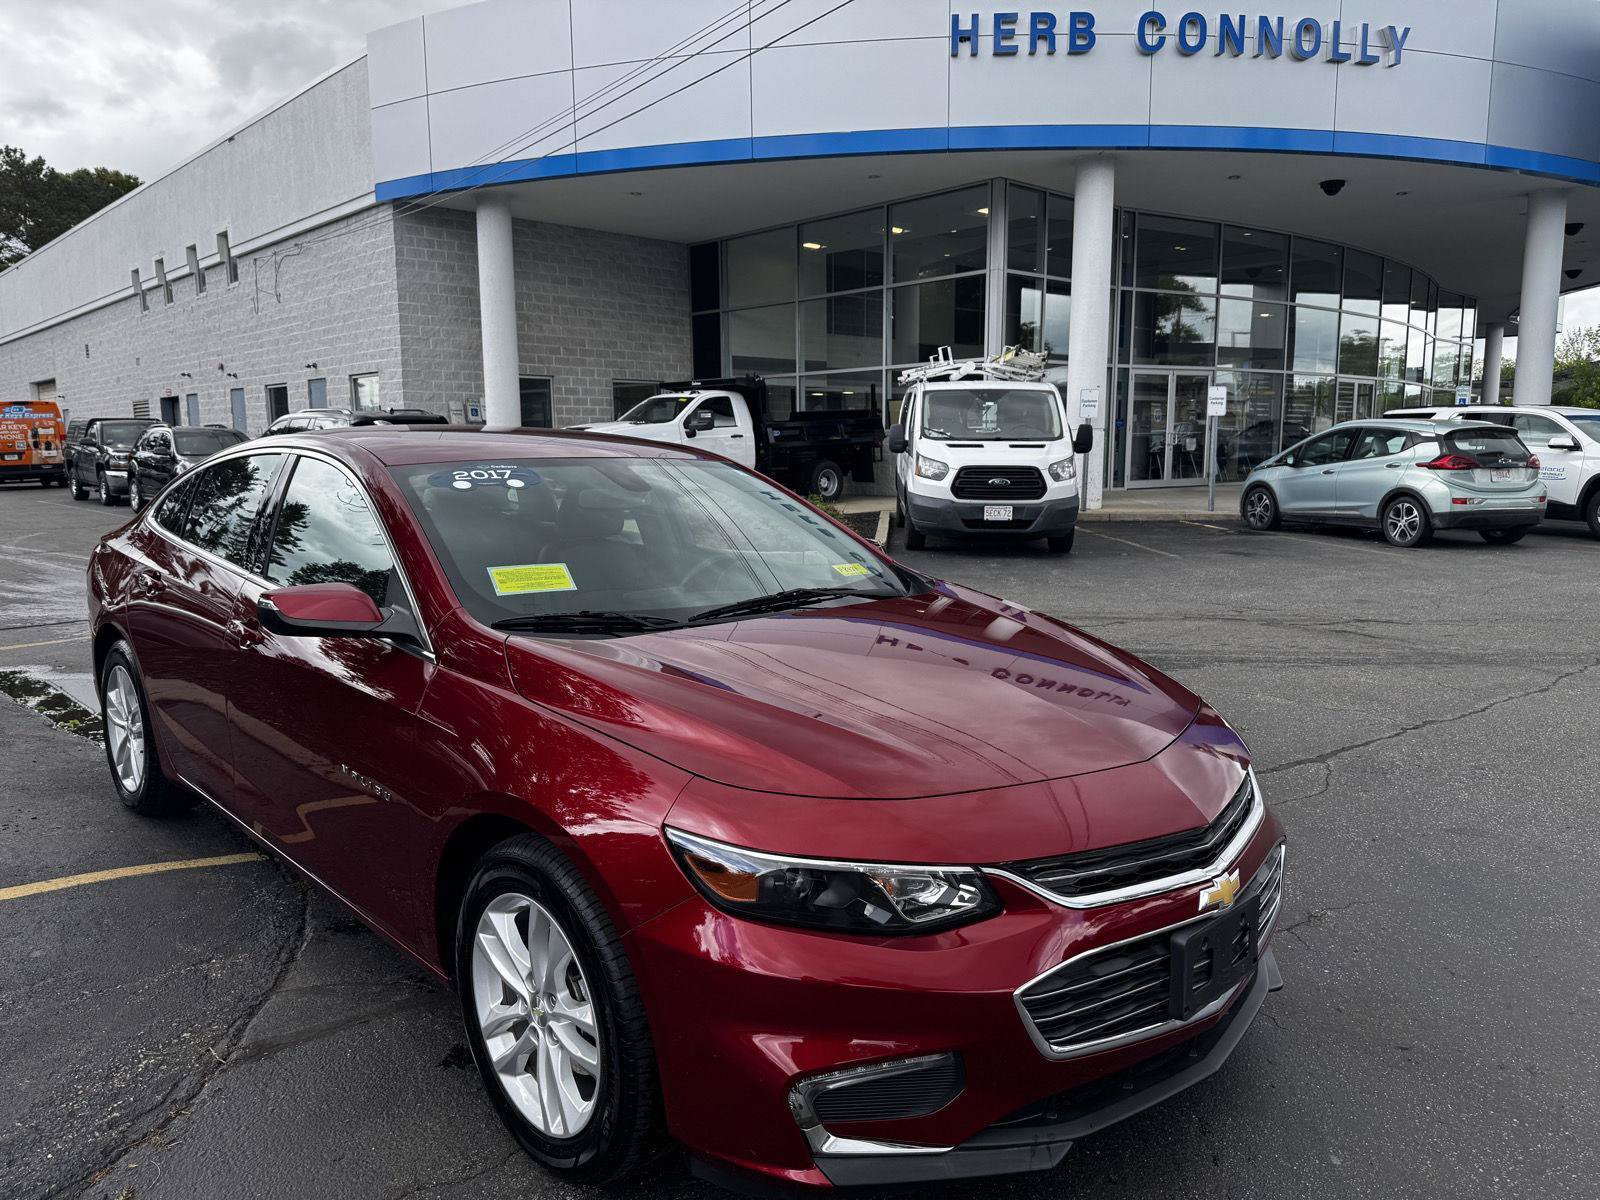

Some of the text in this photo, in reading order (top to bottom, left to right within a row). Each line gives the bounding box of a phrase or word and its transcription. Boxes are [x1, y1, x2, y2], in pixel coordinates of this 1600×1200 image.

[950, 11, 1412, 68] HERB CONNOLLY
[452, 469, 512, 480] 2017
[986, 509, 1011, 517] 5ECK 72
